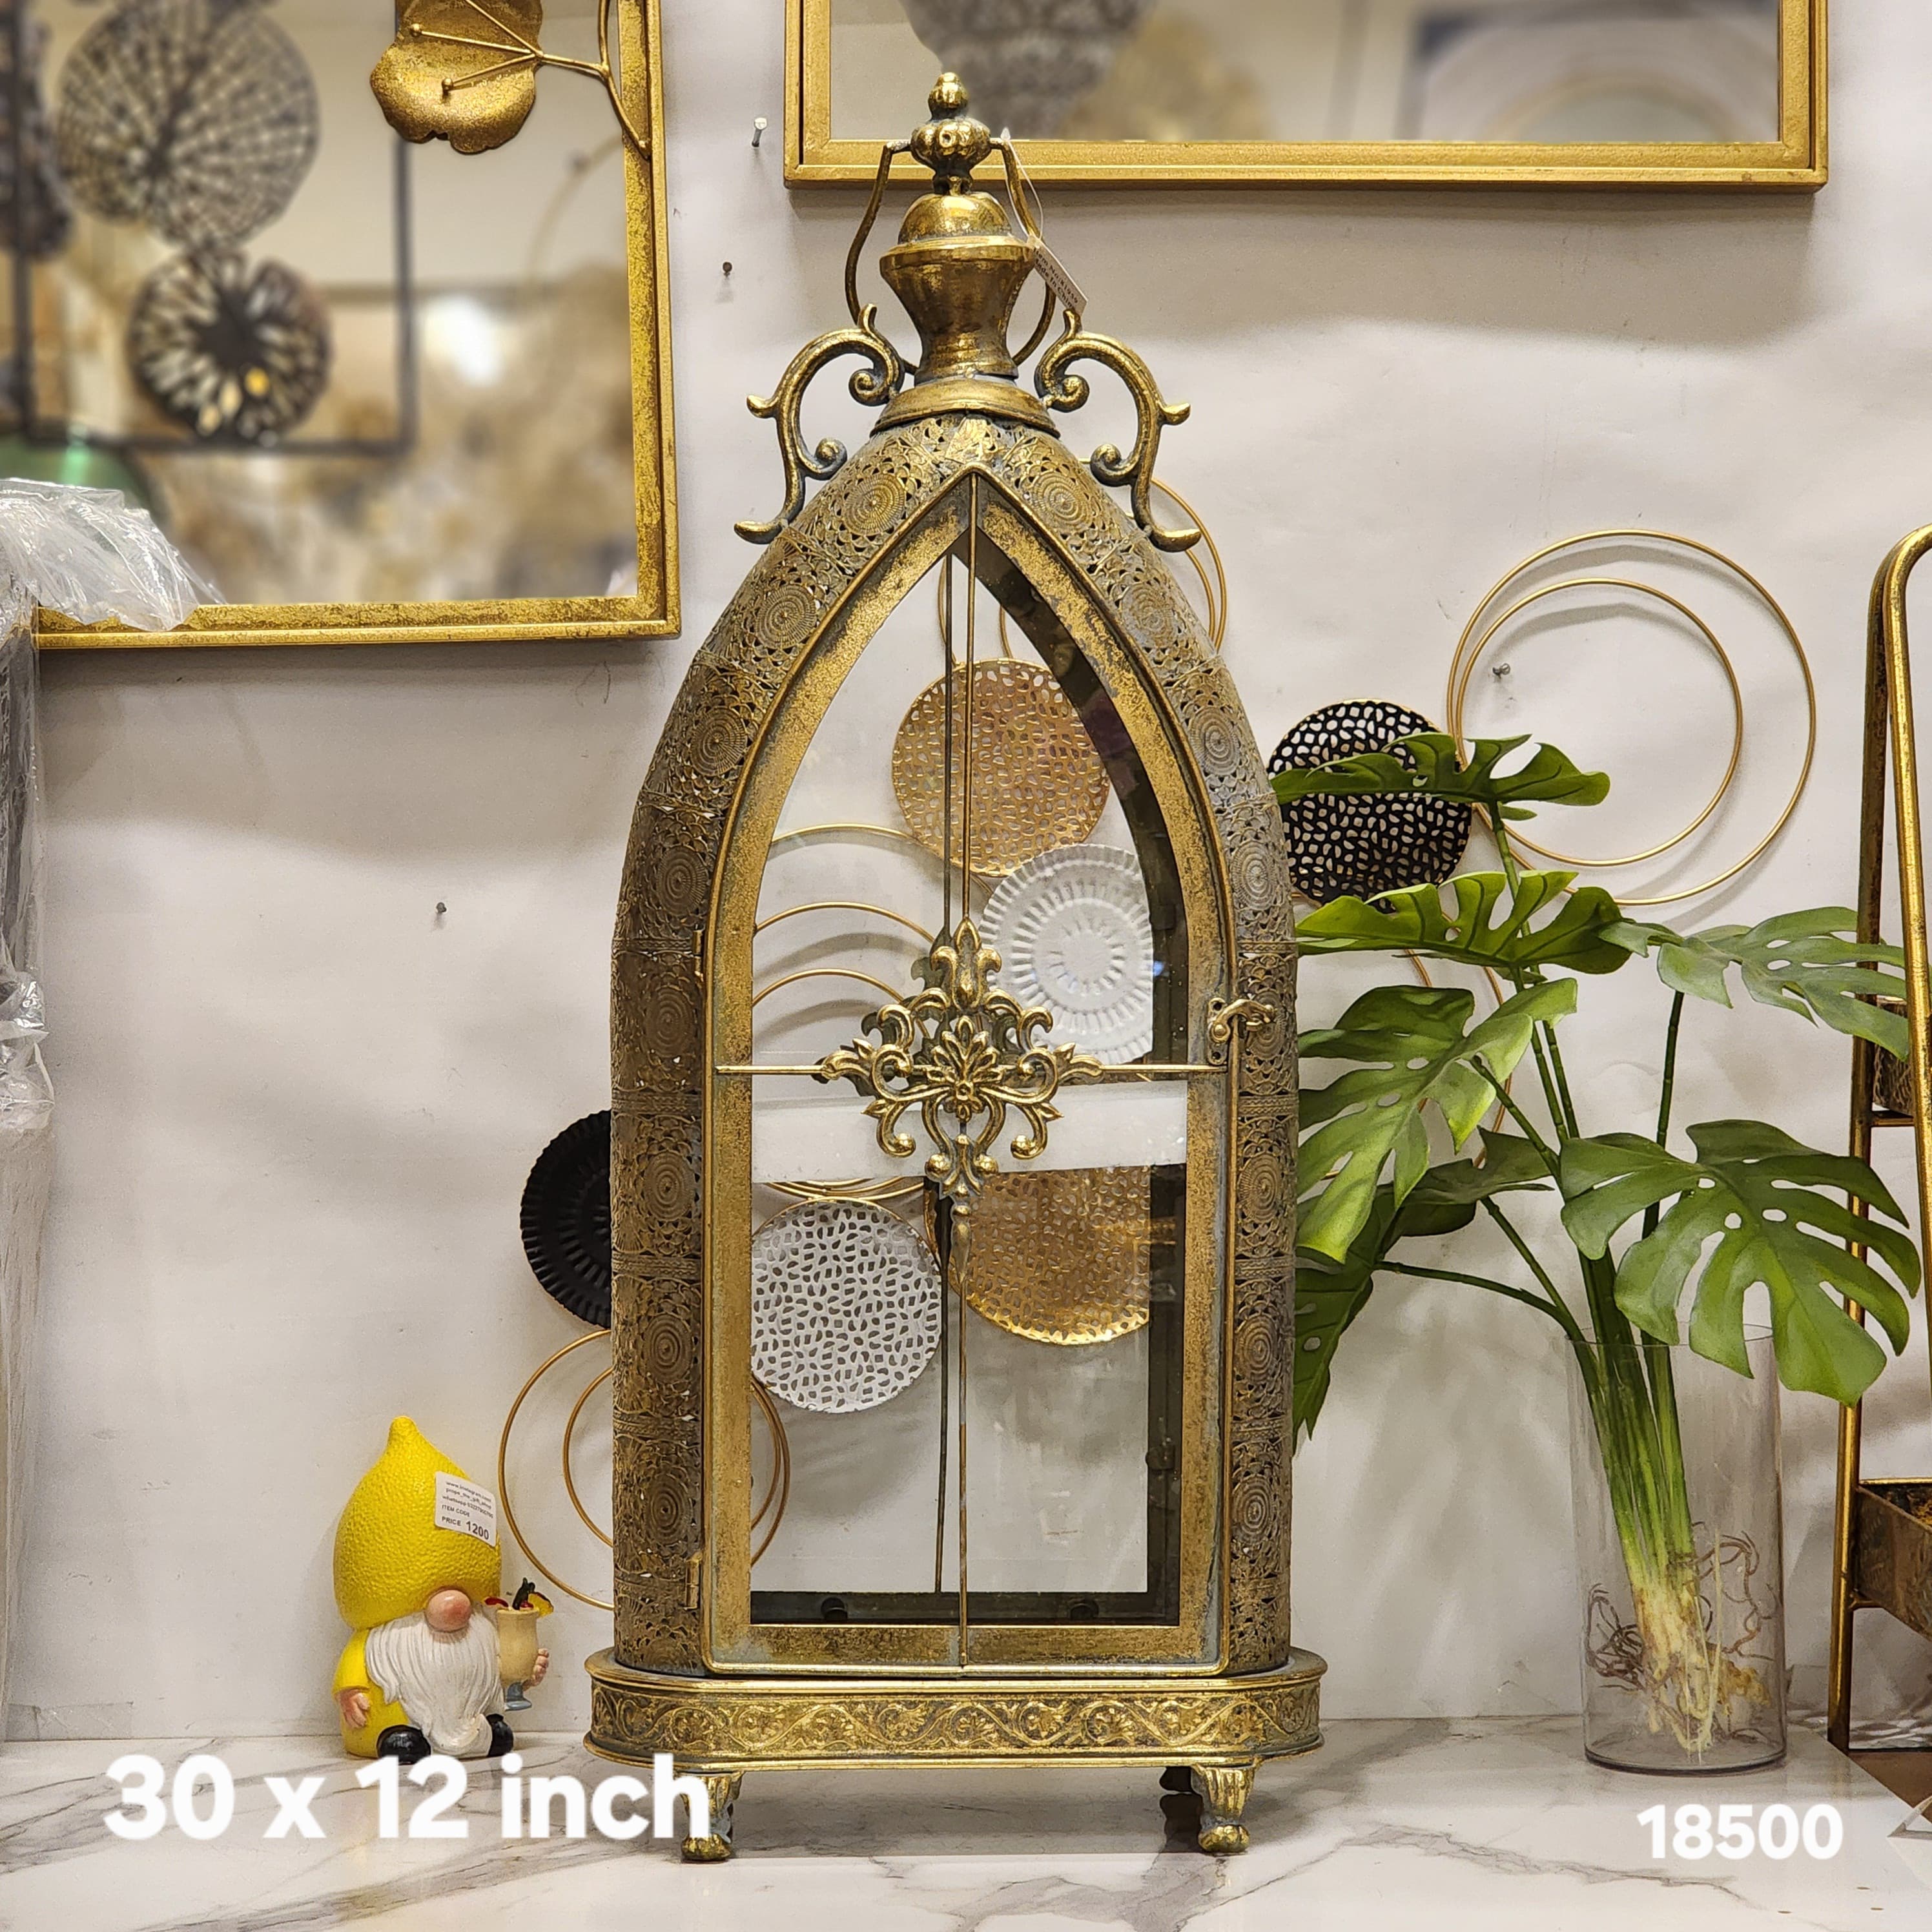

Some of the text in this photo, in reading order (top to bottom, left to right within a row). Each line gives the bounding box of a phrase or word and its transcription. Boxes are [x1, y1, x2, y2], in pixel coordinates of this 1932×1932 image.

[1057, 287, 1073, 309] Chin
[442, 1504, 470, 1517] ITEM CODE
[441, 1516, 489, 1541] PRICE 1200
